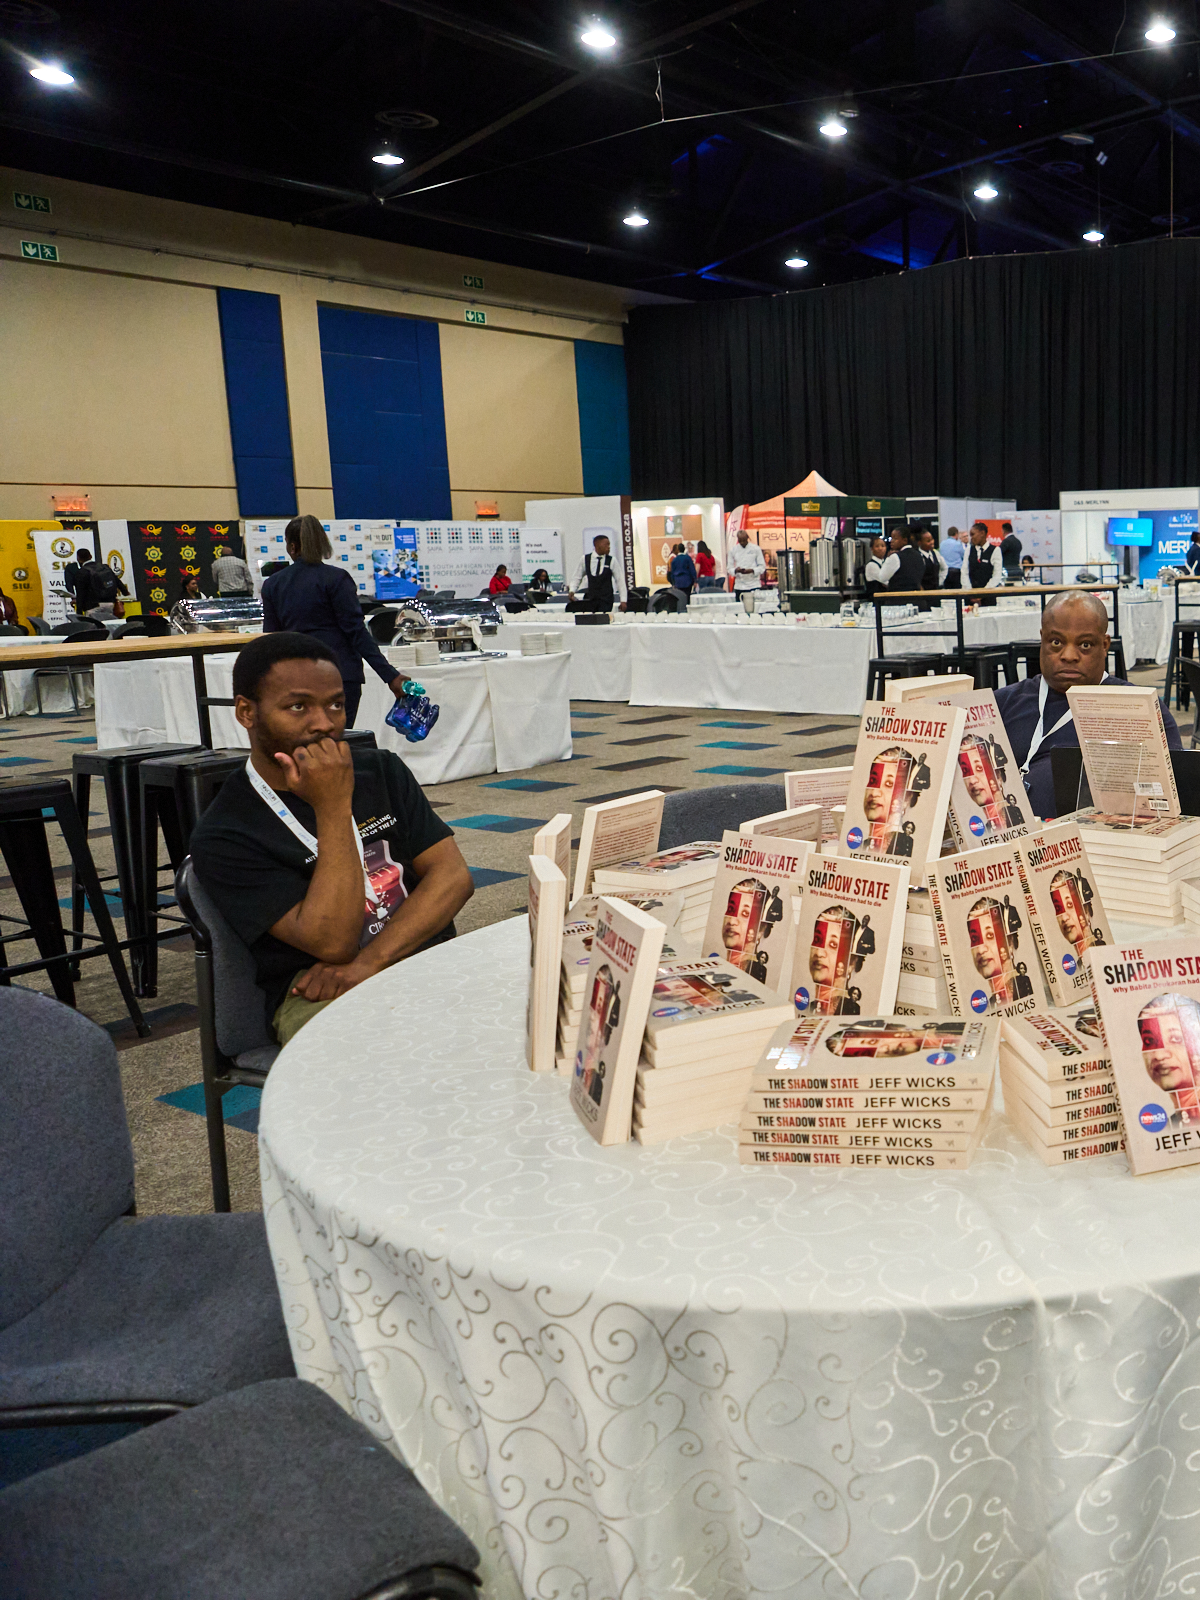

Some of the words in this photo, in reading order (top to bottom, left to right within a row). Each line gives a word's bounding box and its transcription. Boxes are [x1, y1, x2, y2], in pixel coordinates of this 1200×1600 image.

[881, 706, 896, 717] THE
[968, 703, 997, 723] STATE
[865, 716, 911, 734] SHADOW
[911, 720, 947, 739] STATE
[866, 734, 876, 742] Why
[1169, 774, 1177, 799] WICKS
[1001, 827, 1028, 842] WICKS
[1033, 836, 1045, 847] THE
[739, 838, 753, 849] THE
[724, 847, 764, 867] SHADOW
[766, 853, 798, 873] STATE
[1013, 851, 1021, 864] THE
[1028, 843, 1059, 867] SHADOW
[1060, 837, 1082, 856] STATE
[823, 861, 837, 872] THE
[954, 860, 968, 872] THE
[808, 870, 853, 893] SHADOW
[854, 878, 890, 900] STATE
[928, 874, 937, 889] THE
[944, 868, 986, 893] SHADOW
[987, 861, 1014, 882] STATE
[1016, 864, 1031, 894] SHADOW
[810, 889, 819, 897] Why
[820, 890, 833, 898] Babita
[931, 889, 944, 923] SHADOW
[1024, 894, 1036, 916] STATE
[938, 923, 948, 946] STATE
[1033, 922, 1046, 946] JEFF
[616, 934, 637, 967] STATE
[1121, 949, 1144, 961] THE
[943, 953, 956, 981] JEFF
[1041, 949, 1057, 984] WICKS
[1104, 959, 1172, 985] SHADOW
[1113, 986, 1128, 994] Why
[1129, 983, 1152, 991] Babita
[1187, 978, 1199, 986] had
[711, 1000, 766, 1014] WICKS
[1005, 999, 1036, 1017] WICKS
[1062, 1064, 1078, 1076] THE
[768, 1078, 786, 1089] THE
[787, 1078, 828, 1089] SHADOW
[830, 1078, 859, 1089] STATE
[869, 1077, 901, 1089] JEFF
[906, 1077, 956, 1088] WICKS
[763, 1098, 781, 1108] THE
[783, 1097, 823, 1108] SHADOW
[826, 1097, 854, 1108] STATE
[864, 1097, 896, 1108] JEFF
[900, 1097, 951, 1107] WICKS
[1066, 1089, 1082, 1101] THE
[758, 1116, 774, 1127] THE
[776, 1116, 816, 1127] SHADOW
[818, 1117, 846, 1128] STATE
[856, 1117, 888, 1128] JEFF
[892, 1118, 942, 1129] WICKS
[1066, 1110, 1082, 1122] THE
[1064, 1129, 1079, 1140] THE
[1081, 1121, 1118, 1137] SHADOW
[752, 1132, 769, 1143] THE
[771, 1133, 810, 1144] SHADOW
[811, 1134, 839, 1145] STATE
[849, 1135, 880, 1146] JEFF
[884, 1136, 933, 1148] WICKS
[1155, 1132, 1192, 1151] JEFF
[753, 1151, 771, 1162] THE
[772, 1152, 812, 1163] SHADOW
[814, 1153, 841, 1164] STATE
[851, 1154, 882, 1164] JEFF
[886, 1154, 935, 1165] WICKS
[1063, 1150, 1079, 1161] THE
[1081, 1141, 1118, 1157] SHADOW
